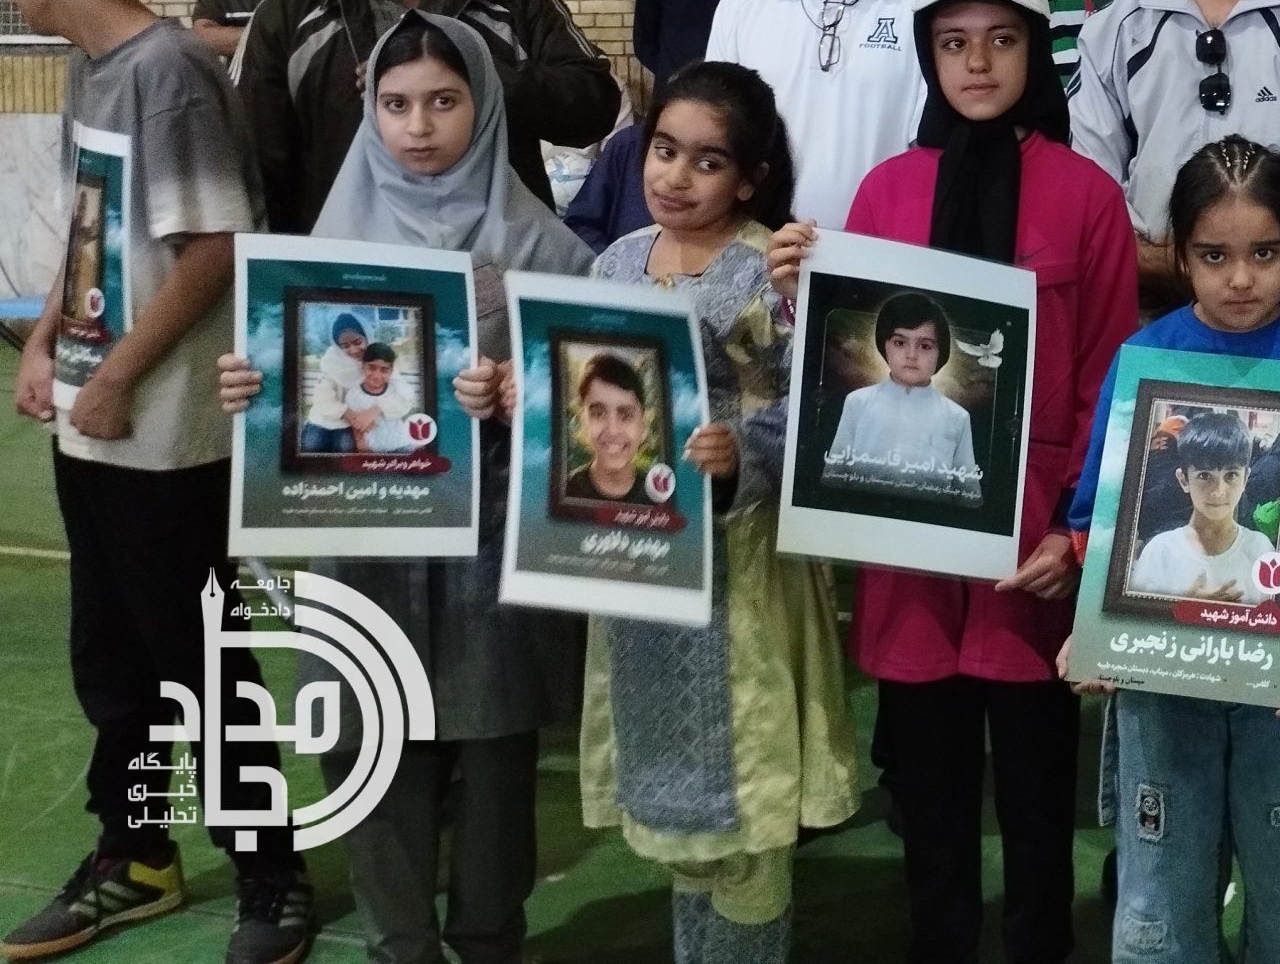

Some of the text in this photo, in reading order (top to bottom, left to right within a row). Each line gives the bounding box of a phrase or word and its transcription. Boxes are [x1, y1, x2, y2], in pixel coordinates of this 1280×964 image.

[867, 17, 898, 44] A
[859, 43, 903, 52] FOOTBALL
[900, 456, 936, 474] امیر
[937, 461, 984, 483] شهید
[345, 482, 378, 501] امین
[1200, 608, 1229, 622] شهید
[1180, 636, 1235, 666] بارانی
[1238, 639, 1274, 671] رضا
